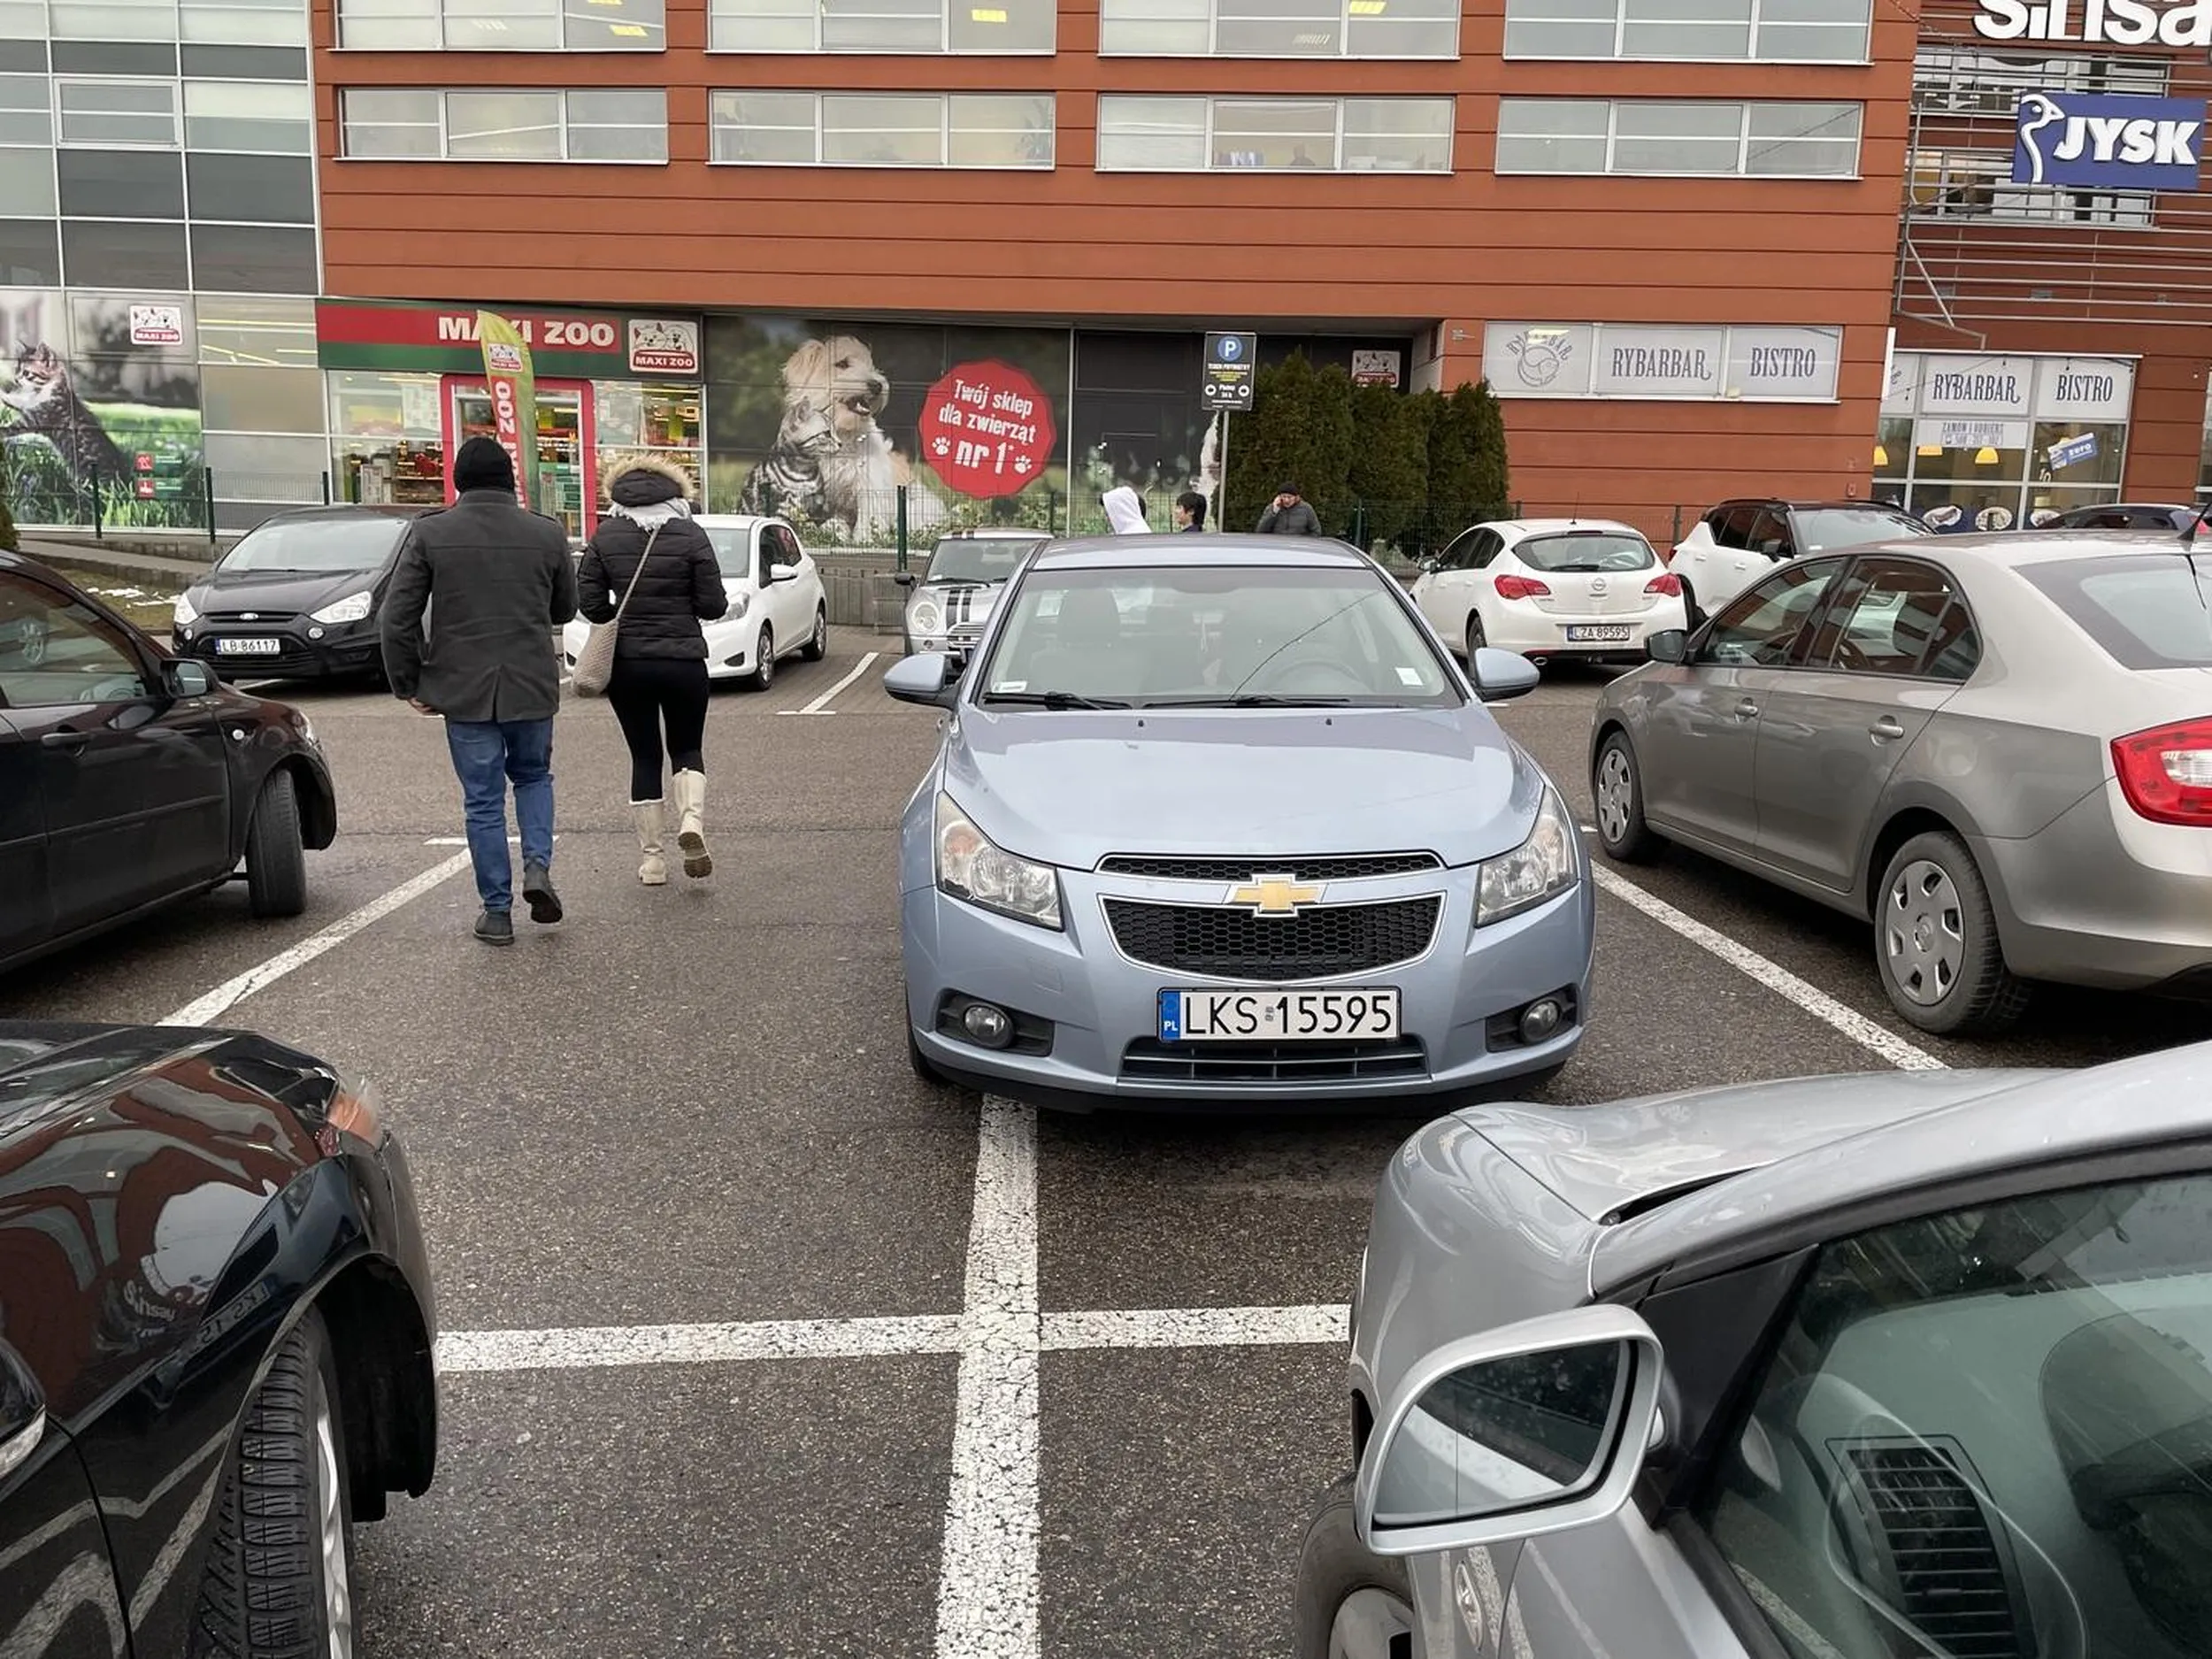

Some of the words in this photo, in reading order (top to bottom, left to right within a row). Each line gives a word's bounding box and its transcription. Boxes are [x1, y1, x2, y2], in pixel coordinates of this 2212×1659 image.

[2054, 117, 2200, 165] JYSK
[439, 316, 533, 343] MI
[544, 320, 615, 346] ZOO
[635, 356, 667, 365] MAXI
[670, 357, 694, 367] ZOO
[1611, 348, 1712, 380] RYBARBAR
[1750, 347, 1816, 378] BISTRO
[954, 379, 990, 410] Twój
[992, 391, 1033, 420] sklep
[1932, 373, 2021, 403] RYBARBAR
[2055, 373, 2114, 403] BISTRO
[495, 380, 516, 434] ZOO
[939, 403, 962, 426] dla
[966, 412, 1037, 446] zwierząt
[955, 440, 990, 468] nr
[1573, 626, 1594, 638] LZA
[1596, 626, 1628, 638] 89595
[1164, 1021, 1178, 1032] PL
[1185, 996, 1258, 1034] LKS
[1276, 995, 1392, 1034] 15595
